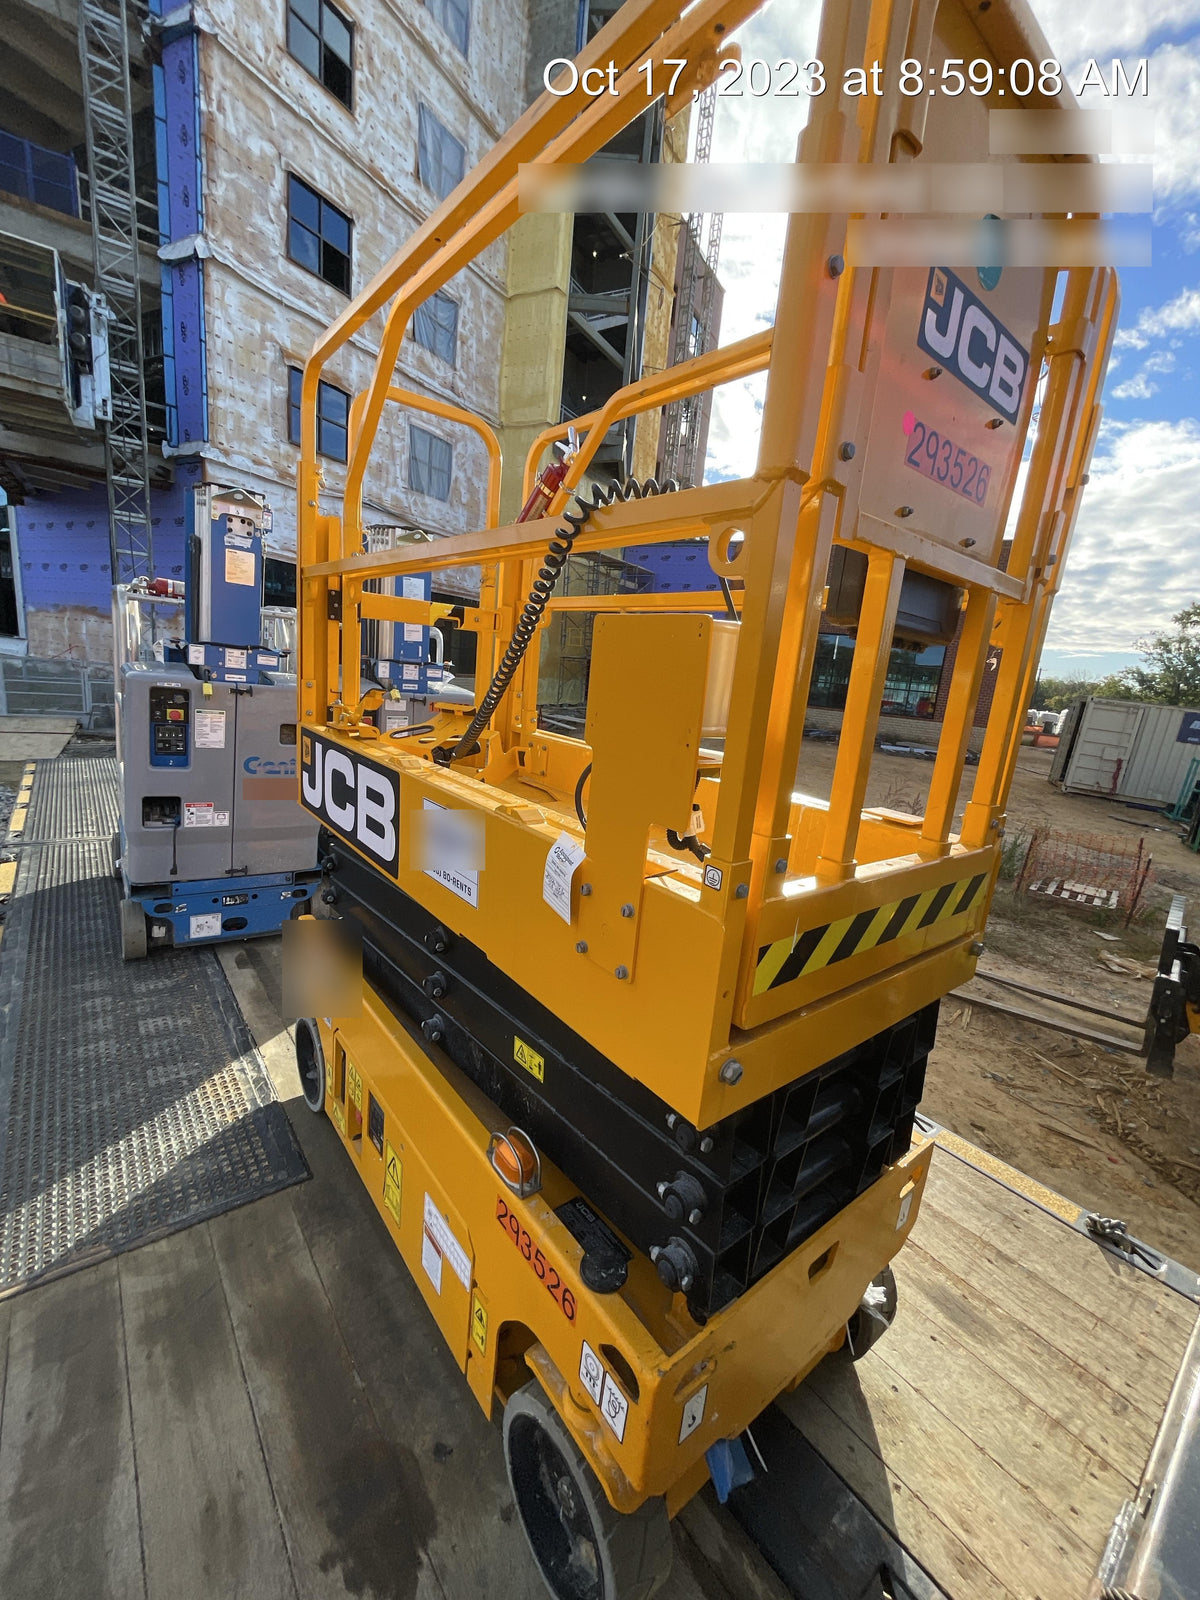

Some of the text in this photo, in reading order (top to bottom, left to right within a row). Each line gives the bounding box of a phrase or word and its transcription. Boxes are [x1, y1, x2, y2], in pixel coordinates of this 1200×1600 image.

[924, 286, 1025, 414] JCB
[906, 421, 990, 502] 293526
[243, 755, 297, 776] Geni
[302, 742, 397, 862] JCB
[497, 1197, 576, 1321] 293526
[575, 1201, 597, 1223] JCB
